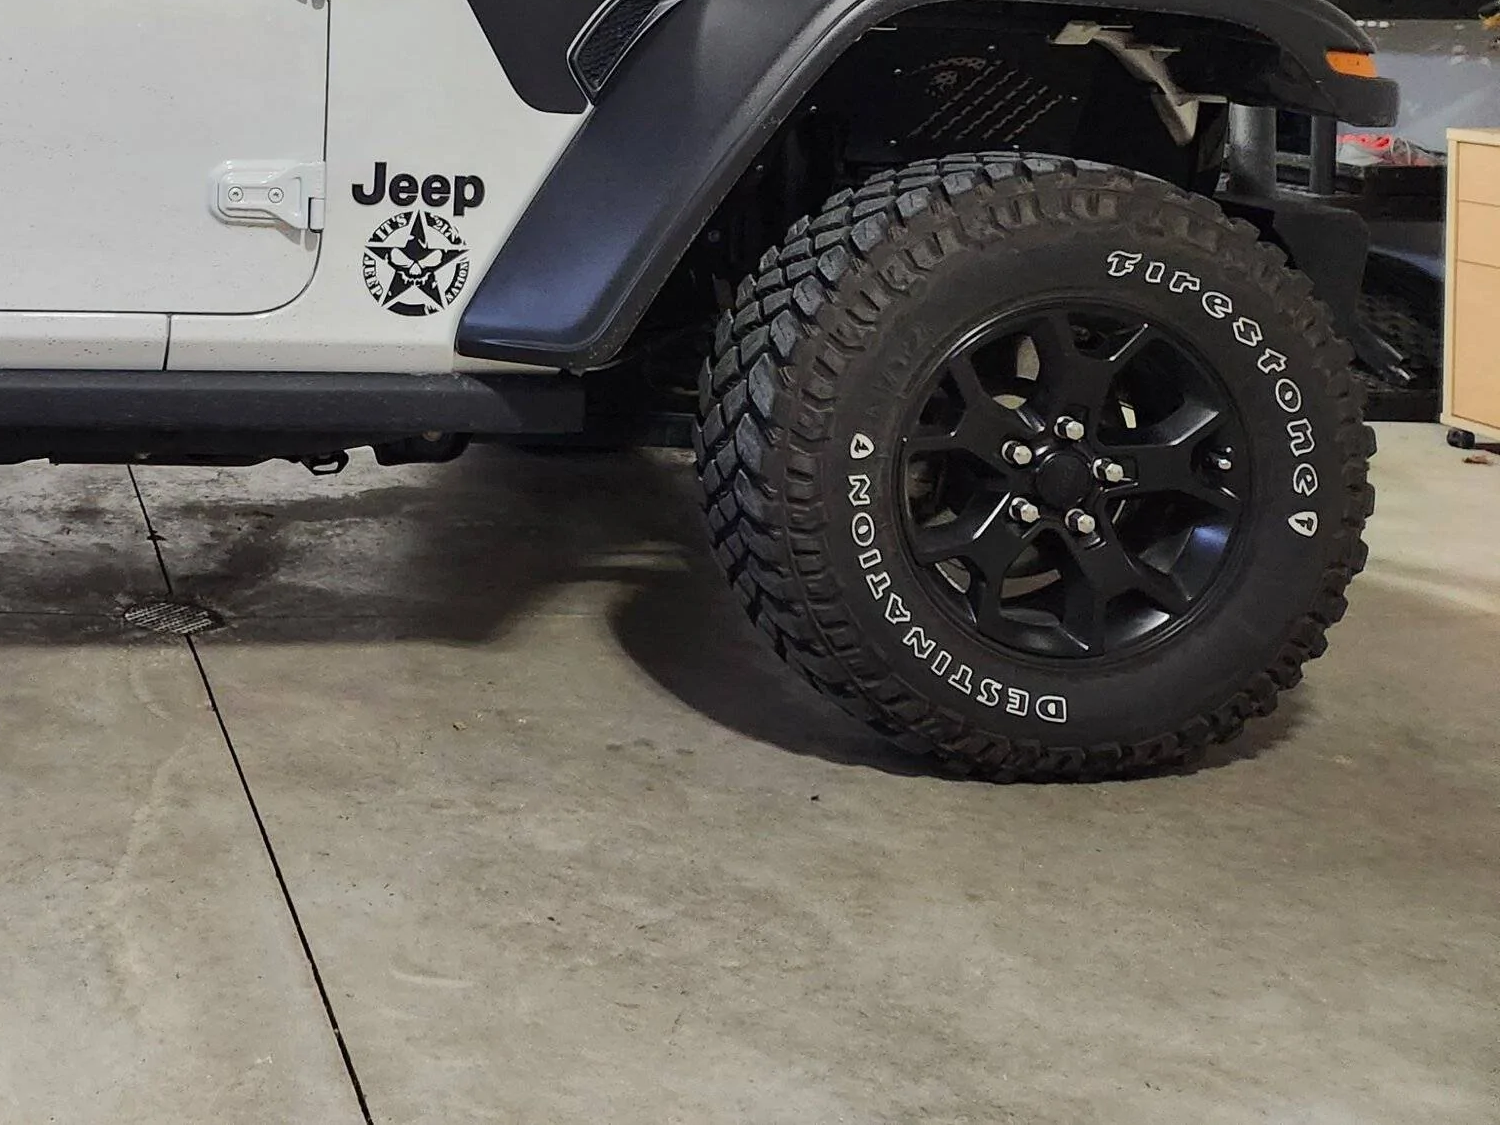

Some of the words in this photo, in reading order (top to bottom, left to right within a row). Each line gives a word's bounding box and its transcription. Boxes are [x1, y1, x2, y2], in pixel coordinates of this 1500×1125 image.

[352, 161, 486, 217] Jeep
[374, 213, 408, 242] IT'S
[363, 256, 384, 297] JEEP
[848, 473, 1068, 724] DESTINATION
